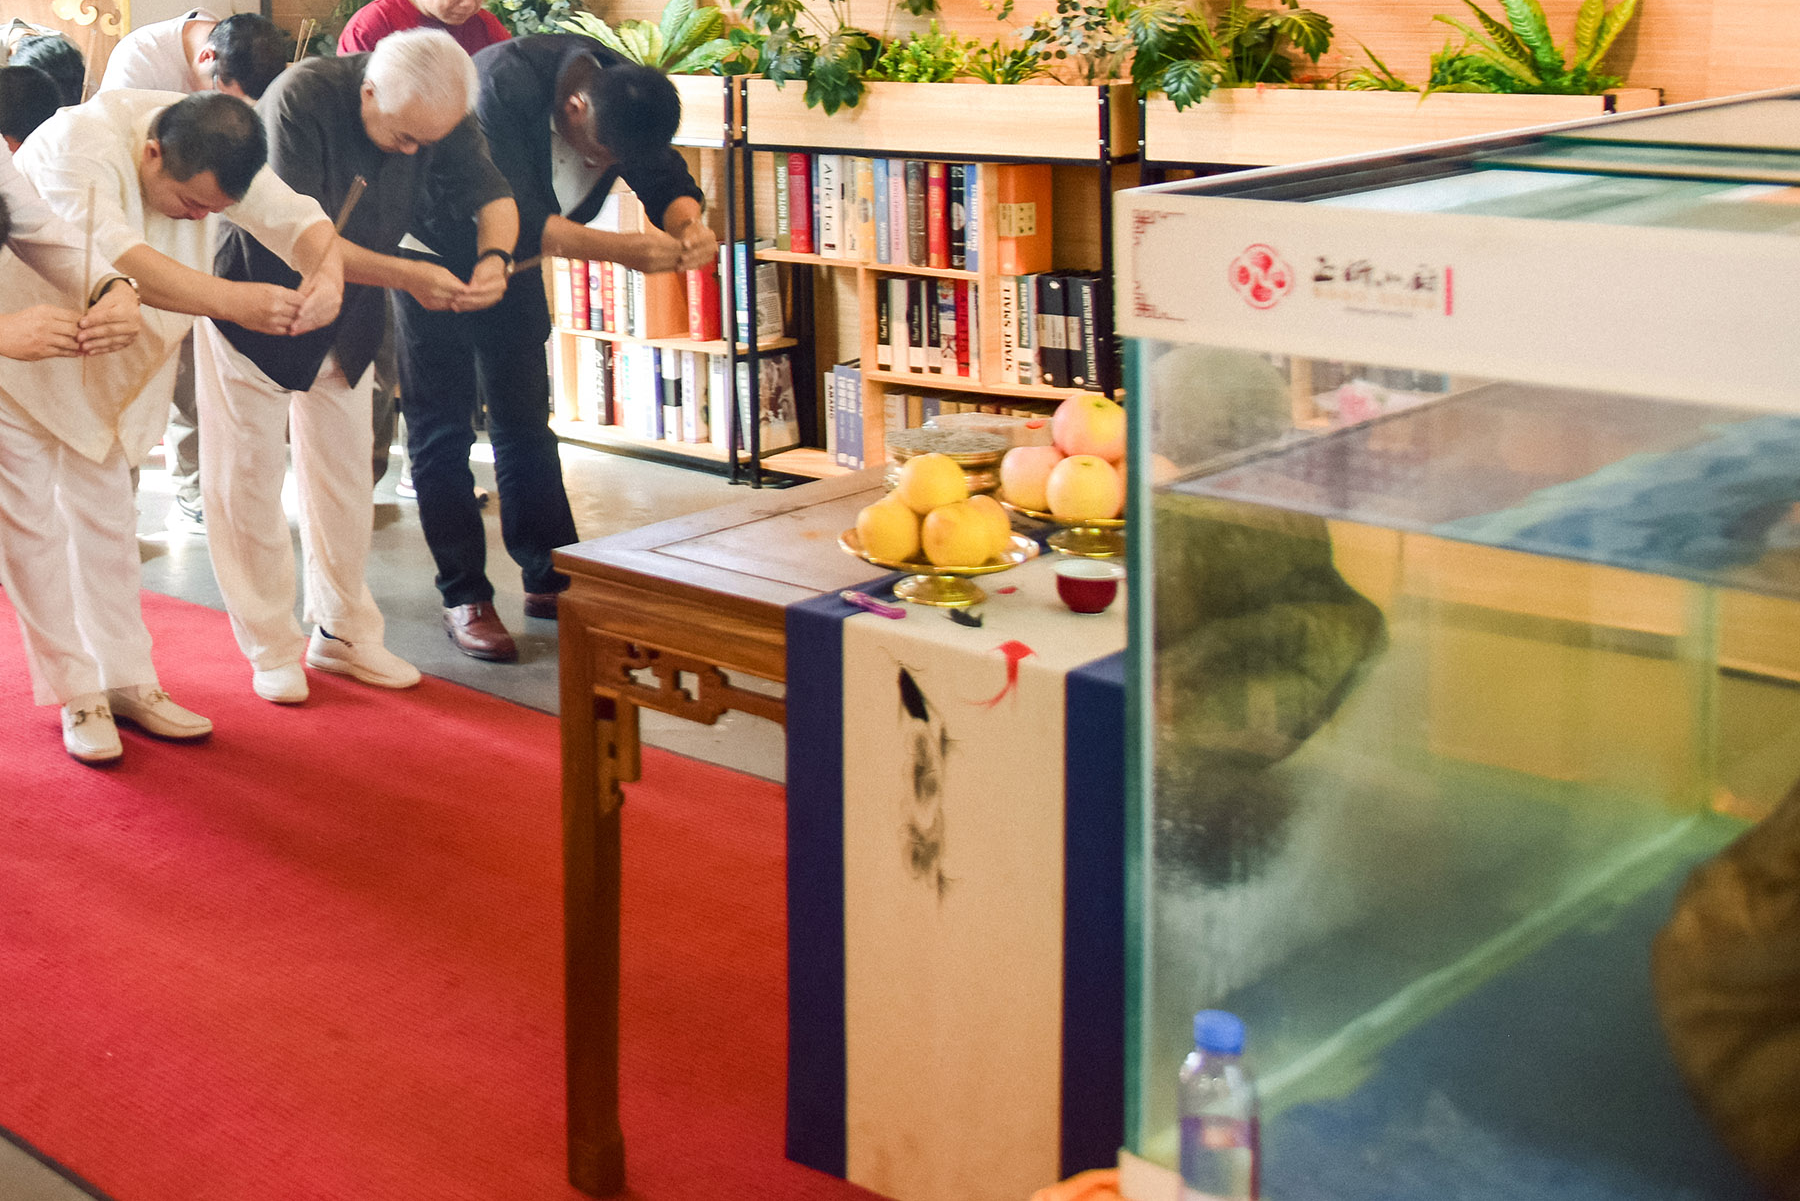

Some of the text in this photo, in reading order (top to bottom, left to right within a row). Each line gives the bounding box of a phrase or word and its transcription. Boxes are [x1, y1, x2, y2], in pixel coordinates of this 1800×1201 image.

[776, 166, 788, 235] THE HOTEL BOOK
[1003, 288, 1012, 371] START SMALL
